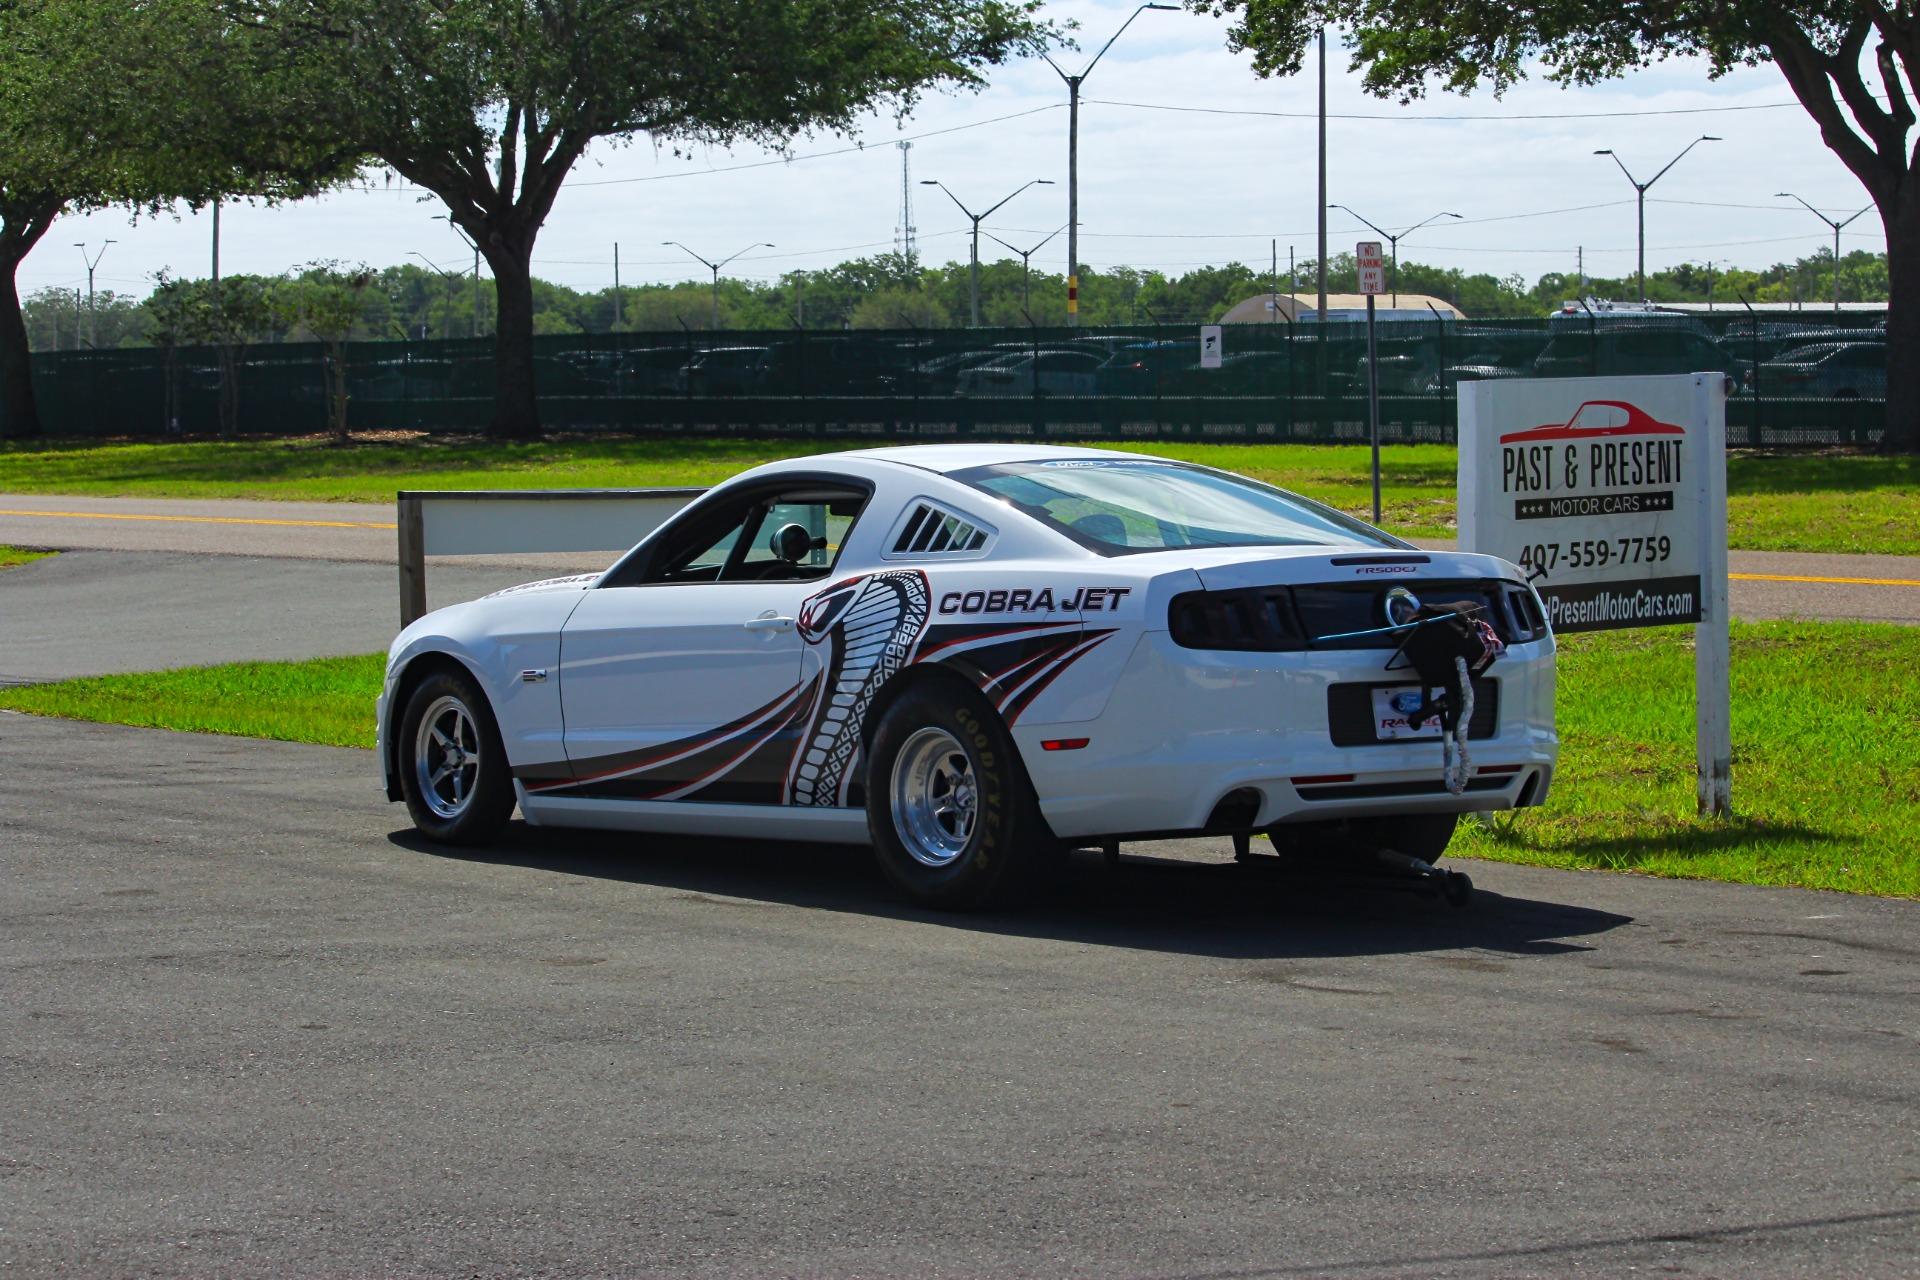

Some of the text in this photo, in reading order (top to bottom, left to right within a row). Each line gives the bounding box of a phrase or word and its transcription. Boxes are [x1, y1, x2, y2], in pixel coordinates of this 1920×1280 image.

[1364, 247, 1374, 256] NO
[1363, 282, 1379, 291] TIME
[1364, 272, 1377, 280] ANY
[1503, 440, 1683, 492] PAST & PRESENT
[1550, 495, 1640, 516] MOTOR CARS
[1519, 535, 1671, 571] 407-559-7759
[938, 587, 1132, 616] COBRA JET
